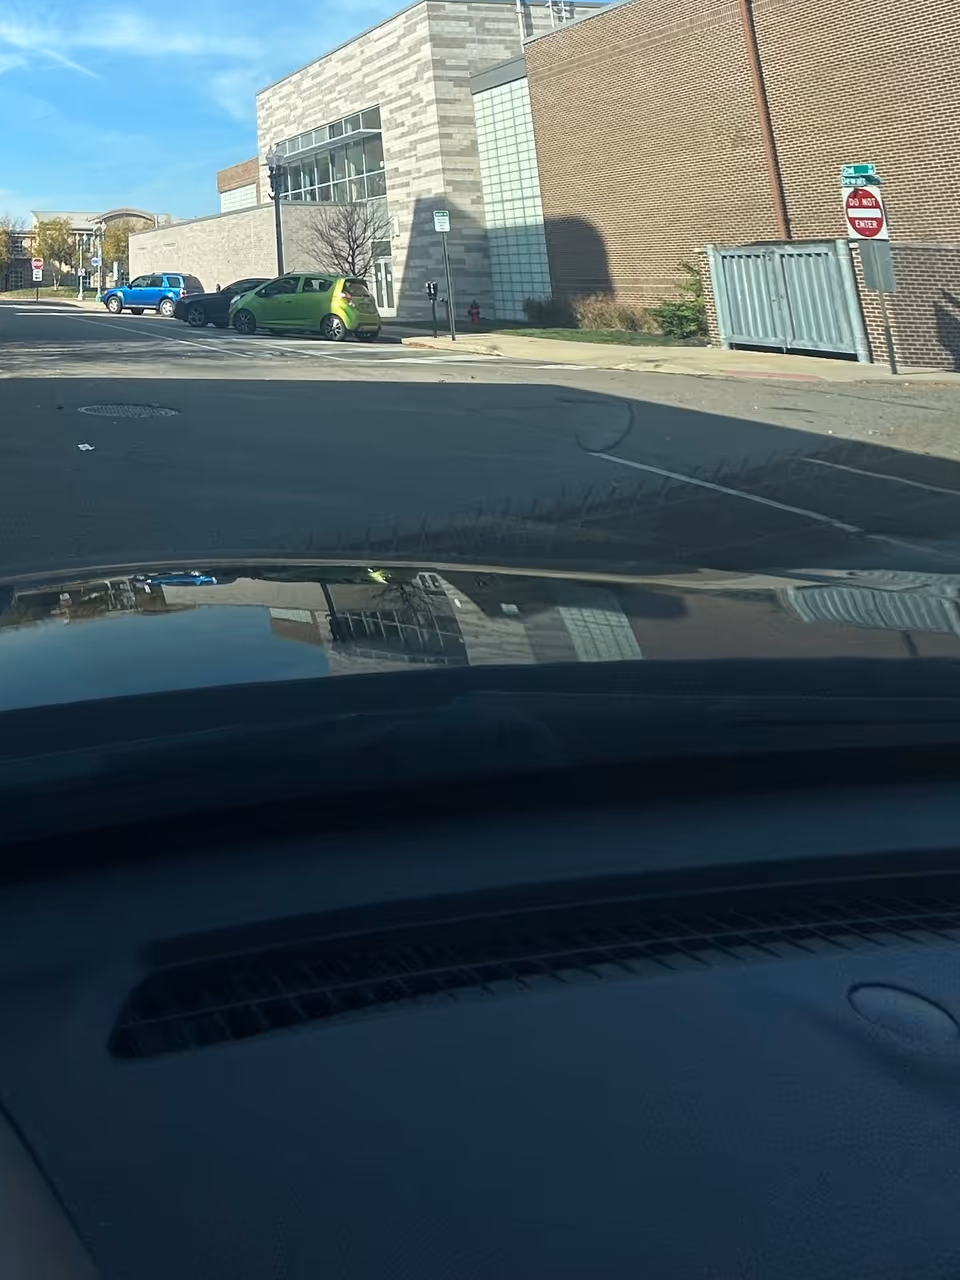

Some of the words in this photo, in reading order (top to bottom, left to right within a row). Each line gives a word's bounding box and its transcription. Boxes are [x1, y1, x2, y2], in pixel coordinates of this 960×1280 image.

[849, 198, 859, 206] DO
[862, 198, 876, 206] NOT
[855, 220, 878, 228] ENTER
